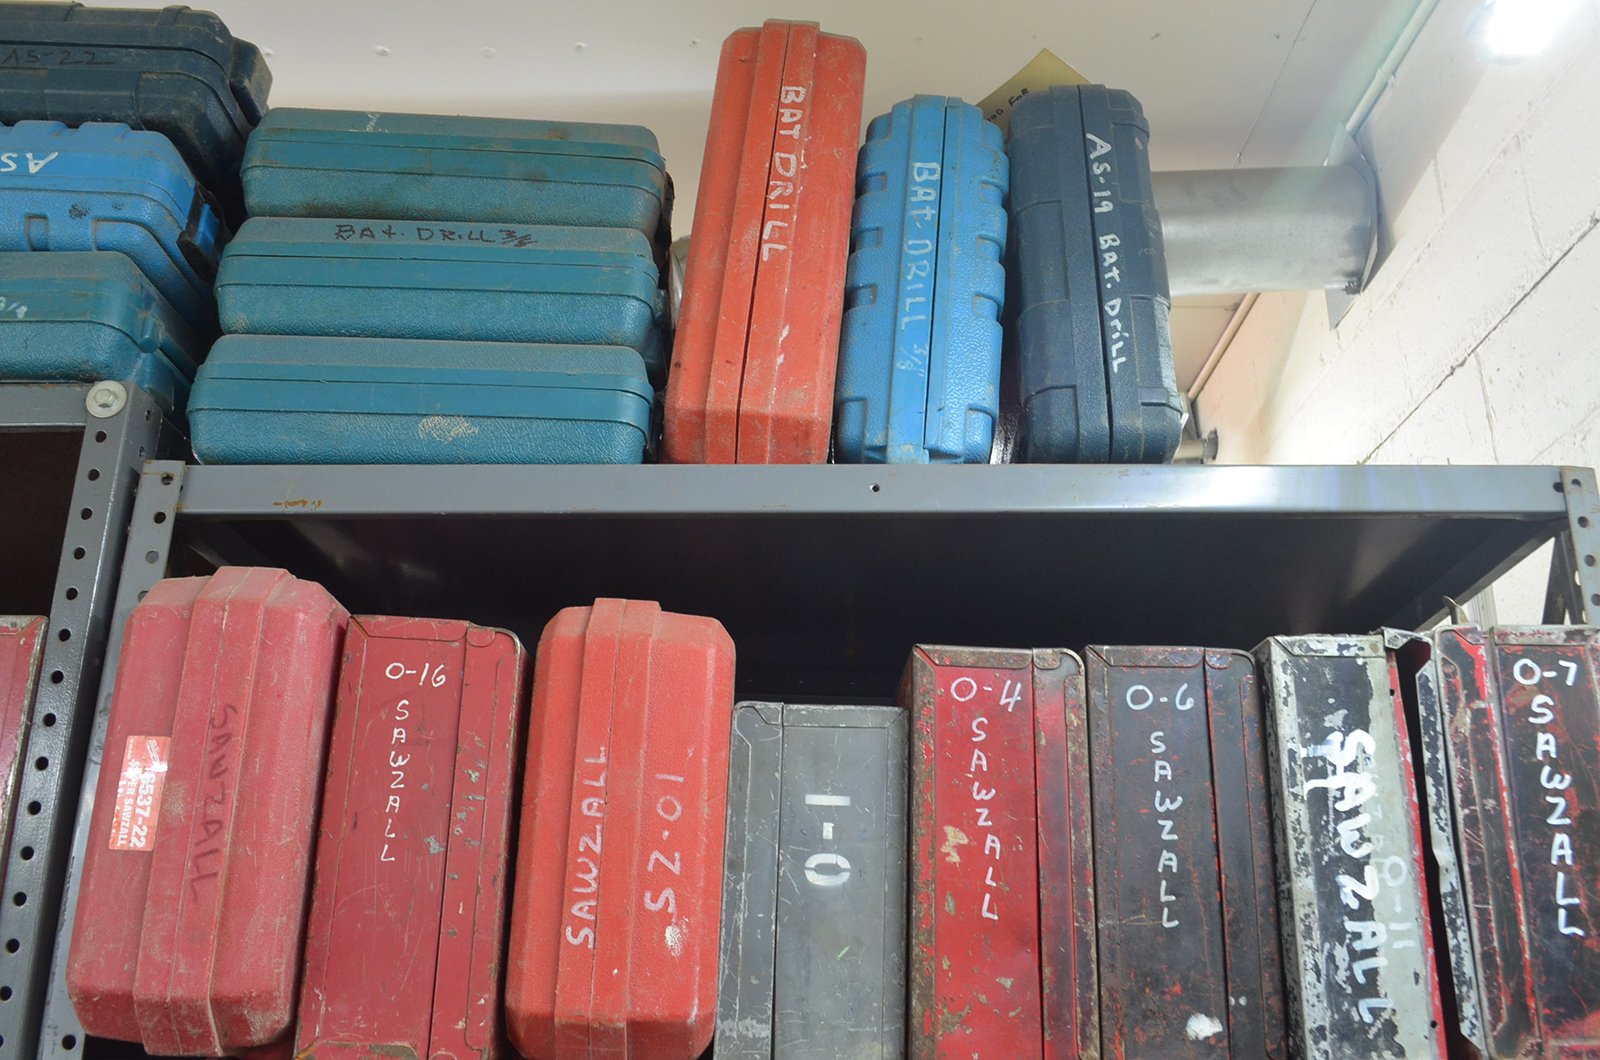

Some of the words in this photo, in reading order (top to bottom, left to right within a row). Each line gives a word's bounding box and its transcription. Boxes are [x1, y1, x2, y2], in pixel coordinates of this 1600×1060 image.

[762, 151, 798, 262] DRILL
[779, 85, 807, 140] BAT
[117, 797, 134, 847] SAWZALL
[130, 770, 156, 848] 6537-22
[189, 703, 237, 896] SAWZALL
[380, 699, 410, 862] SAWZALL
[565, 746, 608, 949] SAWZALL
[969, 717, 999, 921] SAWZALL
[1149, 731, 1184, 929] SAWZALL
[1322, 729, 1393, 1024] SAWZALL
[1528, 694, 1585, 937] SAWZALL
